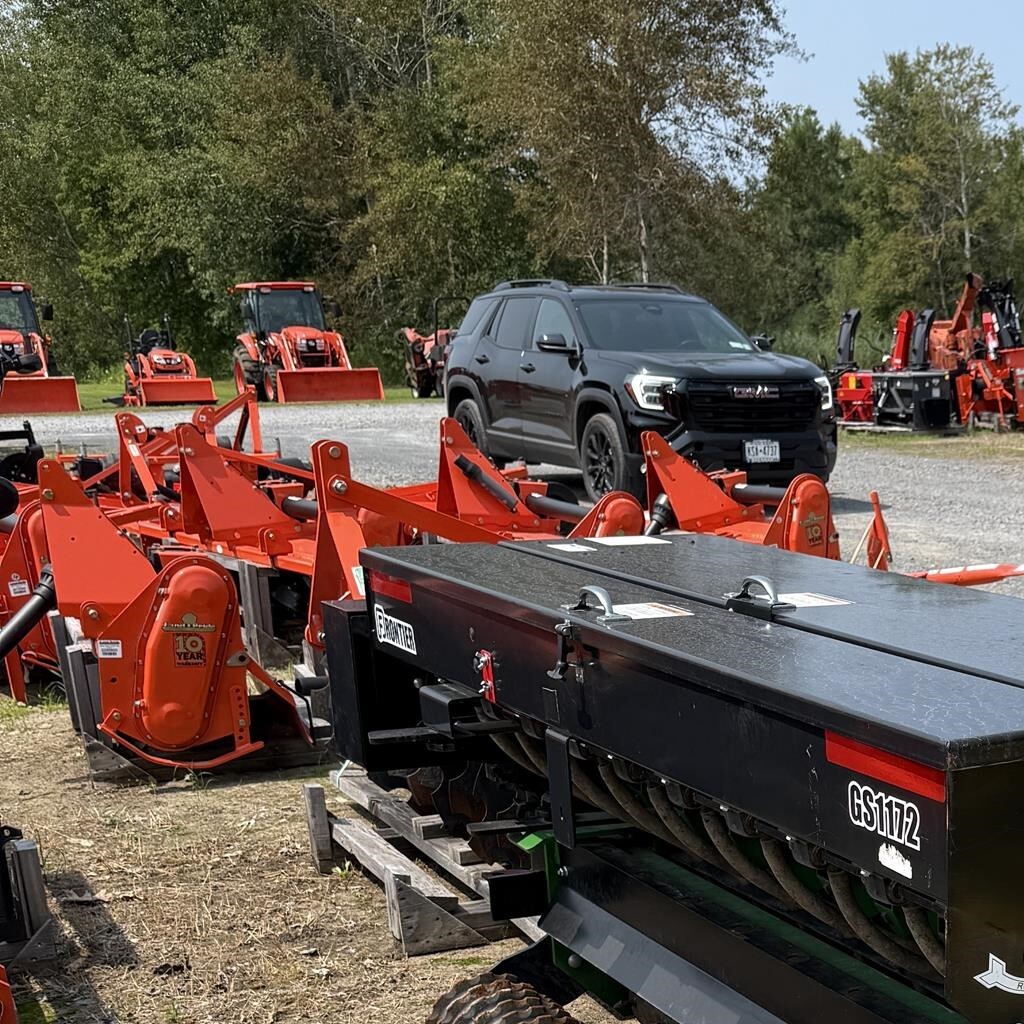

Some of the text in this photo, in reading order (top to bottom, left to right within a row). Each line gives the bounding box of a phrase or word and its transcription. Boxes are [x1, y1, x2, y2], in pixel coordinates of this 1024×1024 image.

[176, 636, 203, 653] 10
[375, 604, 417, 654] FRONTIER
[176, 652, 203, 661] YEAR
[849, 782, 920, 850] GS1172
